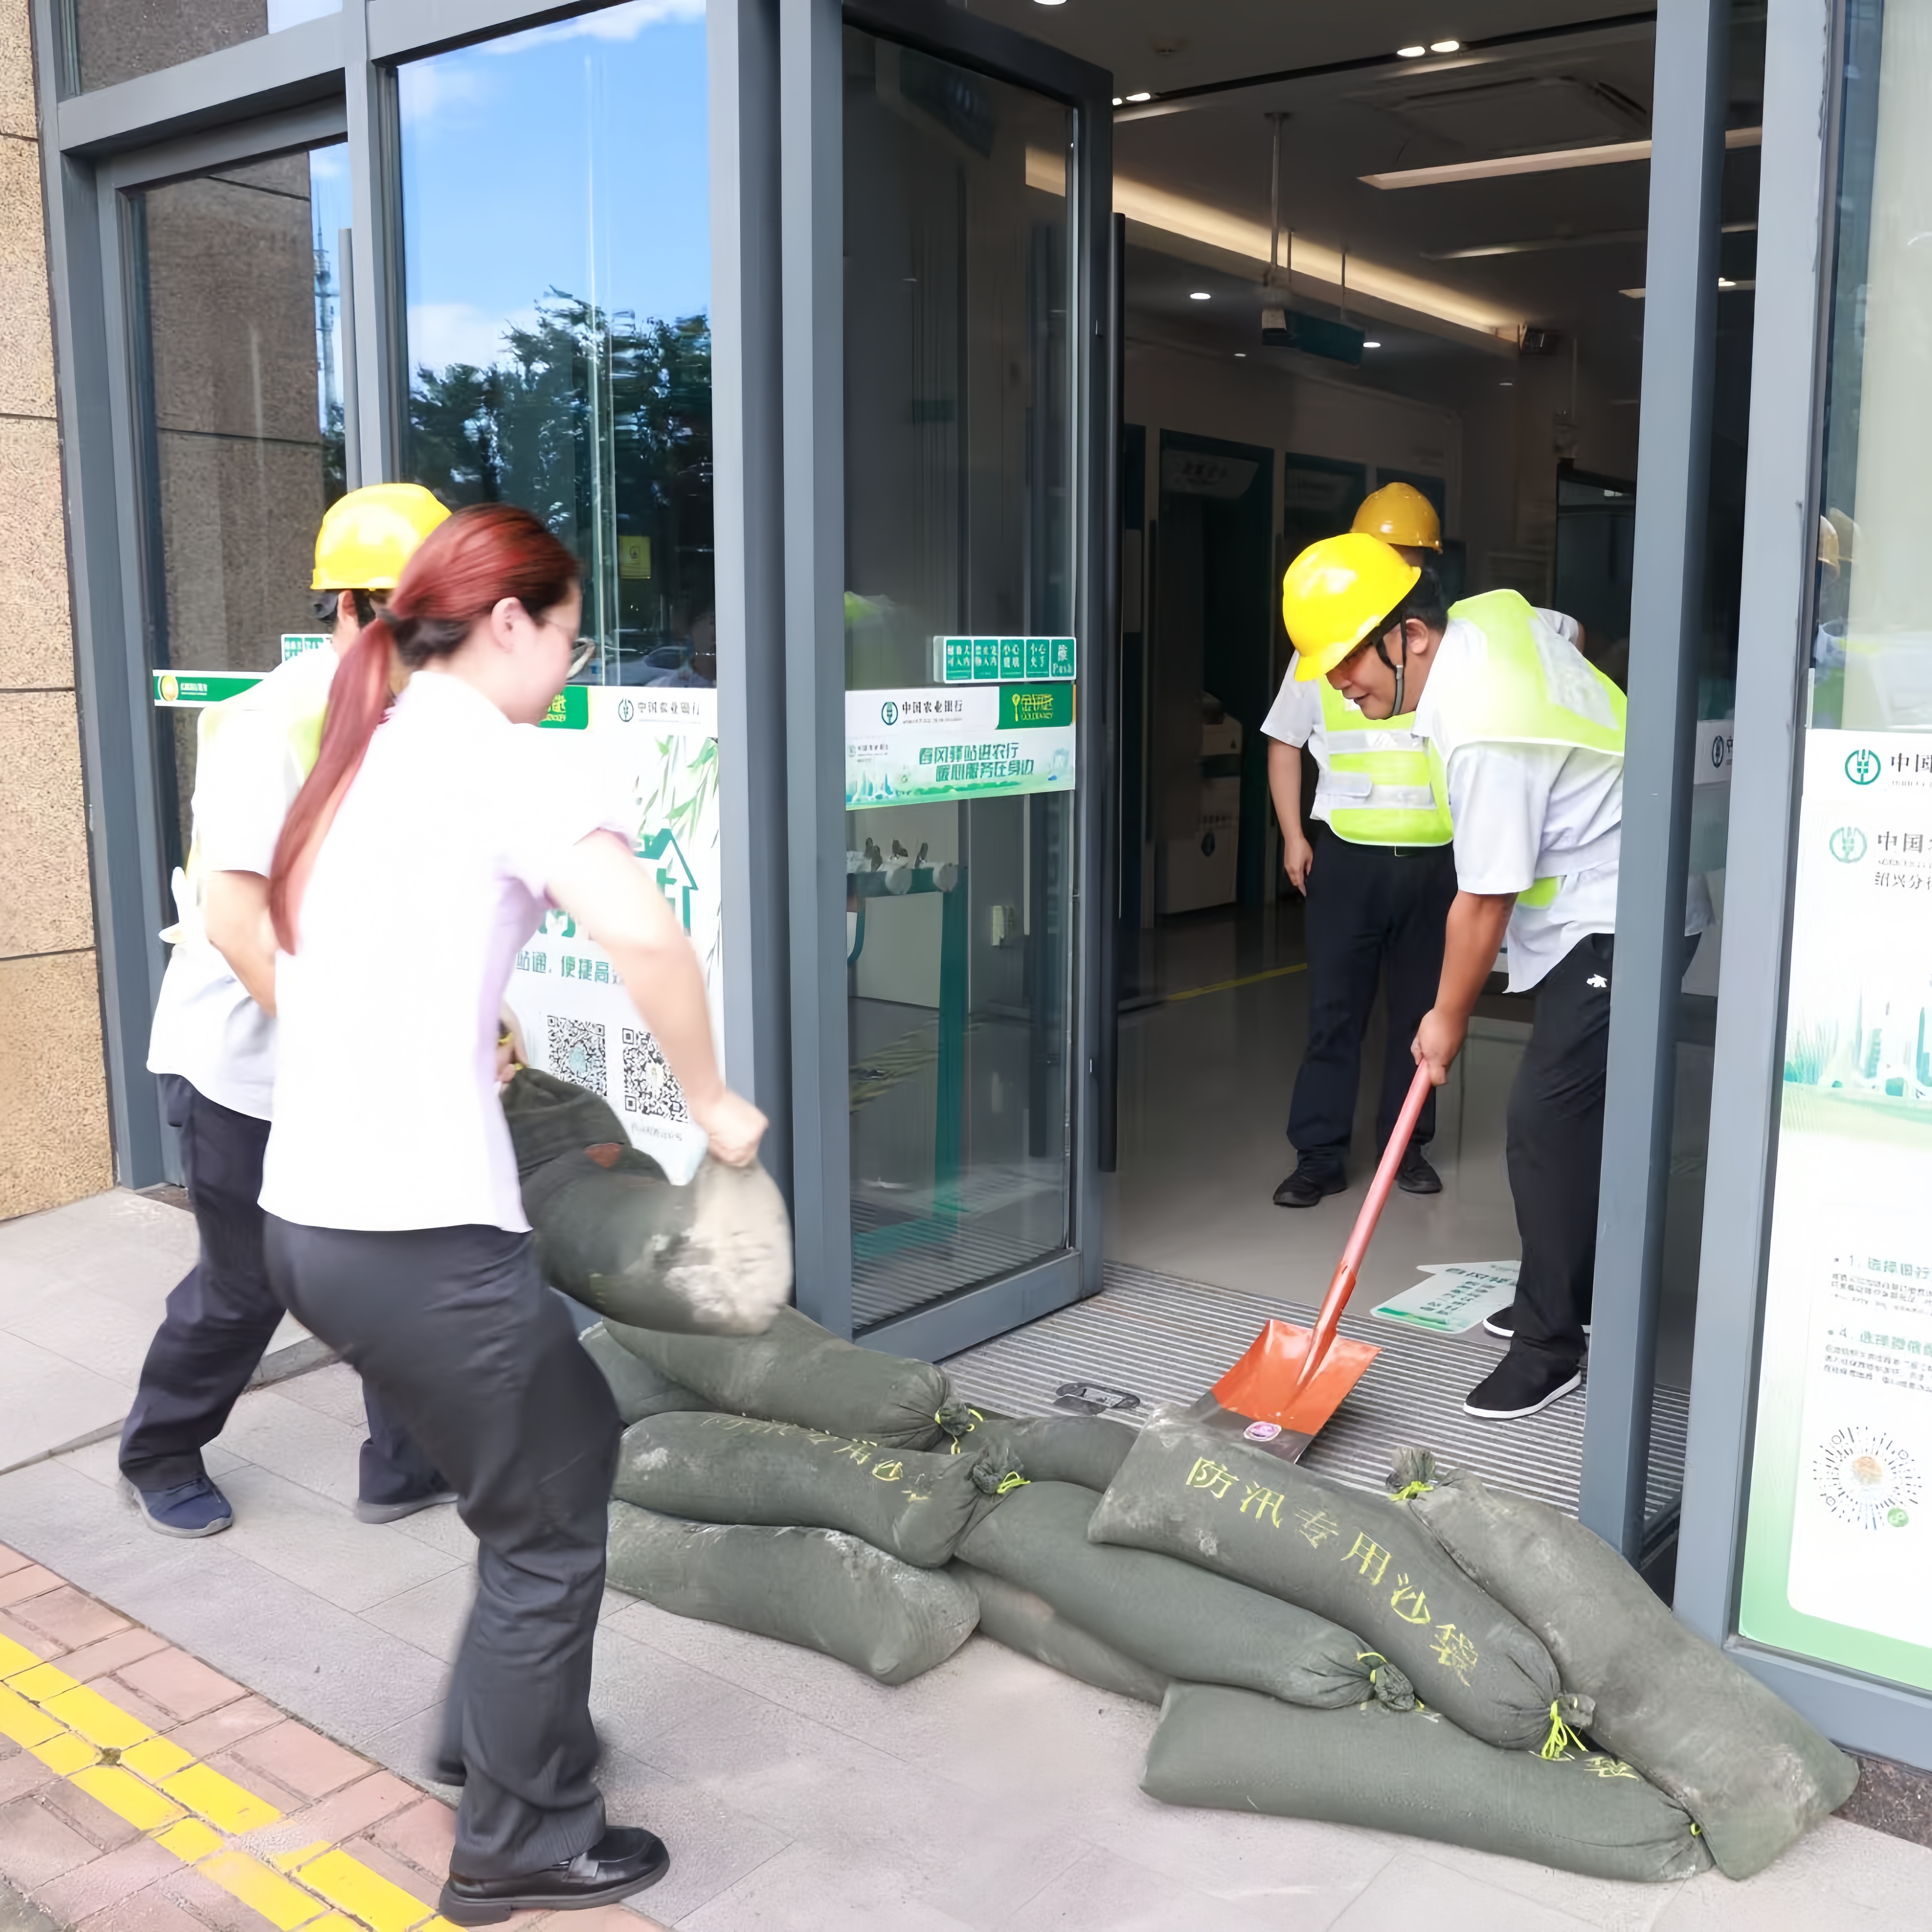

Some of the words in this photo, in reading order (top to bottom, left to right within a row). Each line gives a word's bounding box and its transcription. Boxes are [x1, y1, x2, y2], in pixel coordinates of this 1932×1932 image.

[902, 700, 963, 714] 中国农业银行
[1878, 831, 1932, 854] 中国
